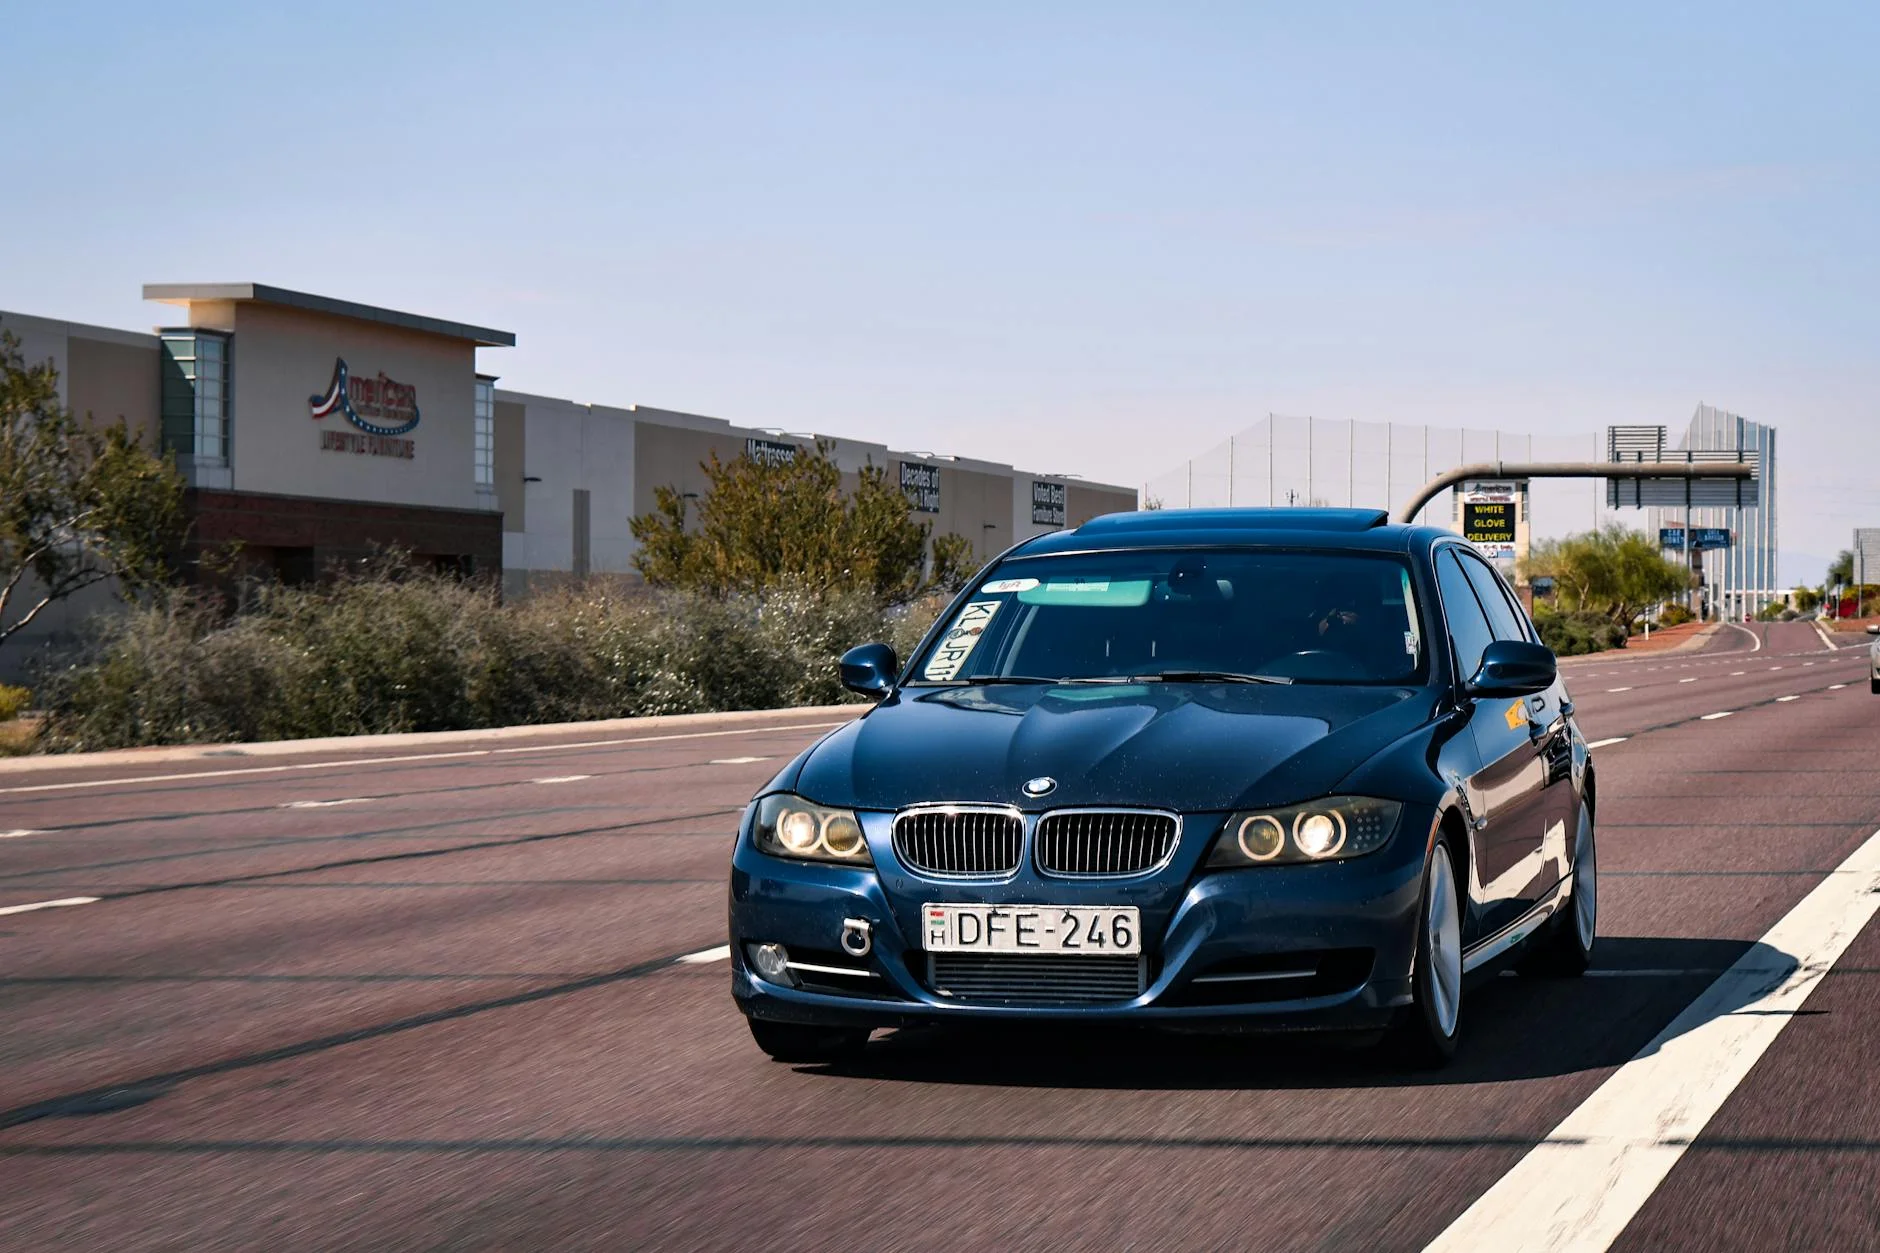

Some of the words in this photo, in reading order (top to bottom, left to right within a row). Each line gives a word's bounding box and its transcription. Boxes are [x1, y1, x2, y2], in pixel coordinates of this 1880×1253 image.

[308, 356, 420, 435] American
[901, 463, 930, 487] Decades
[1474, 505, 1504, 513] WHITE
[1474, 519, 1505, 527] GLOVE
[1467, 533, 1512, 541] DELIVERY
[958, 603, 995, 627] KL
[931, 930, 945, 945] H
[958, 912, 1132, 948] DFE-246
